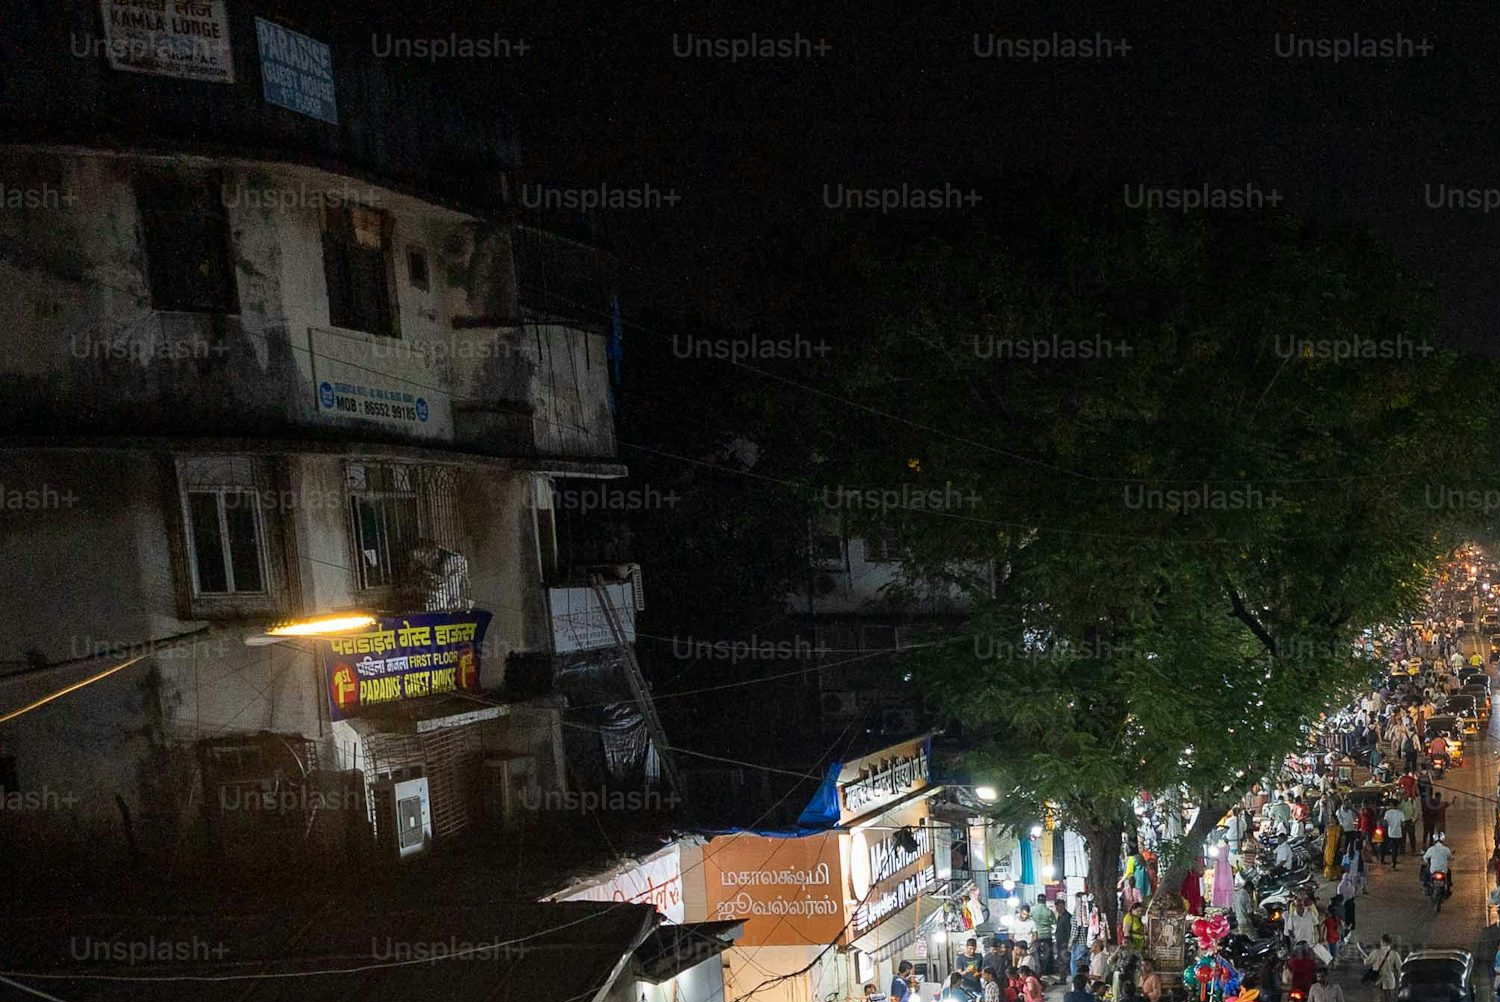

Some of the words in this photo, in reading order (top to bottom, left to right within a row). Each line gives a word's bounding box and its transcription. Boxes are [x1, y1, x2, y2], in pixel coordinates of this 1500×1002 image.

[336, 396, 357, 412] MOB
[409, 654, 431, 668] FIRST
[433, 650, 458, 665] FLOOR
[360, 674, 402, 705] PARADISE
[404, 670, 430, 699] GUEST
[432, 668, 457, 694] HOUSE
